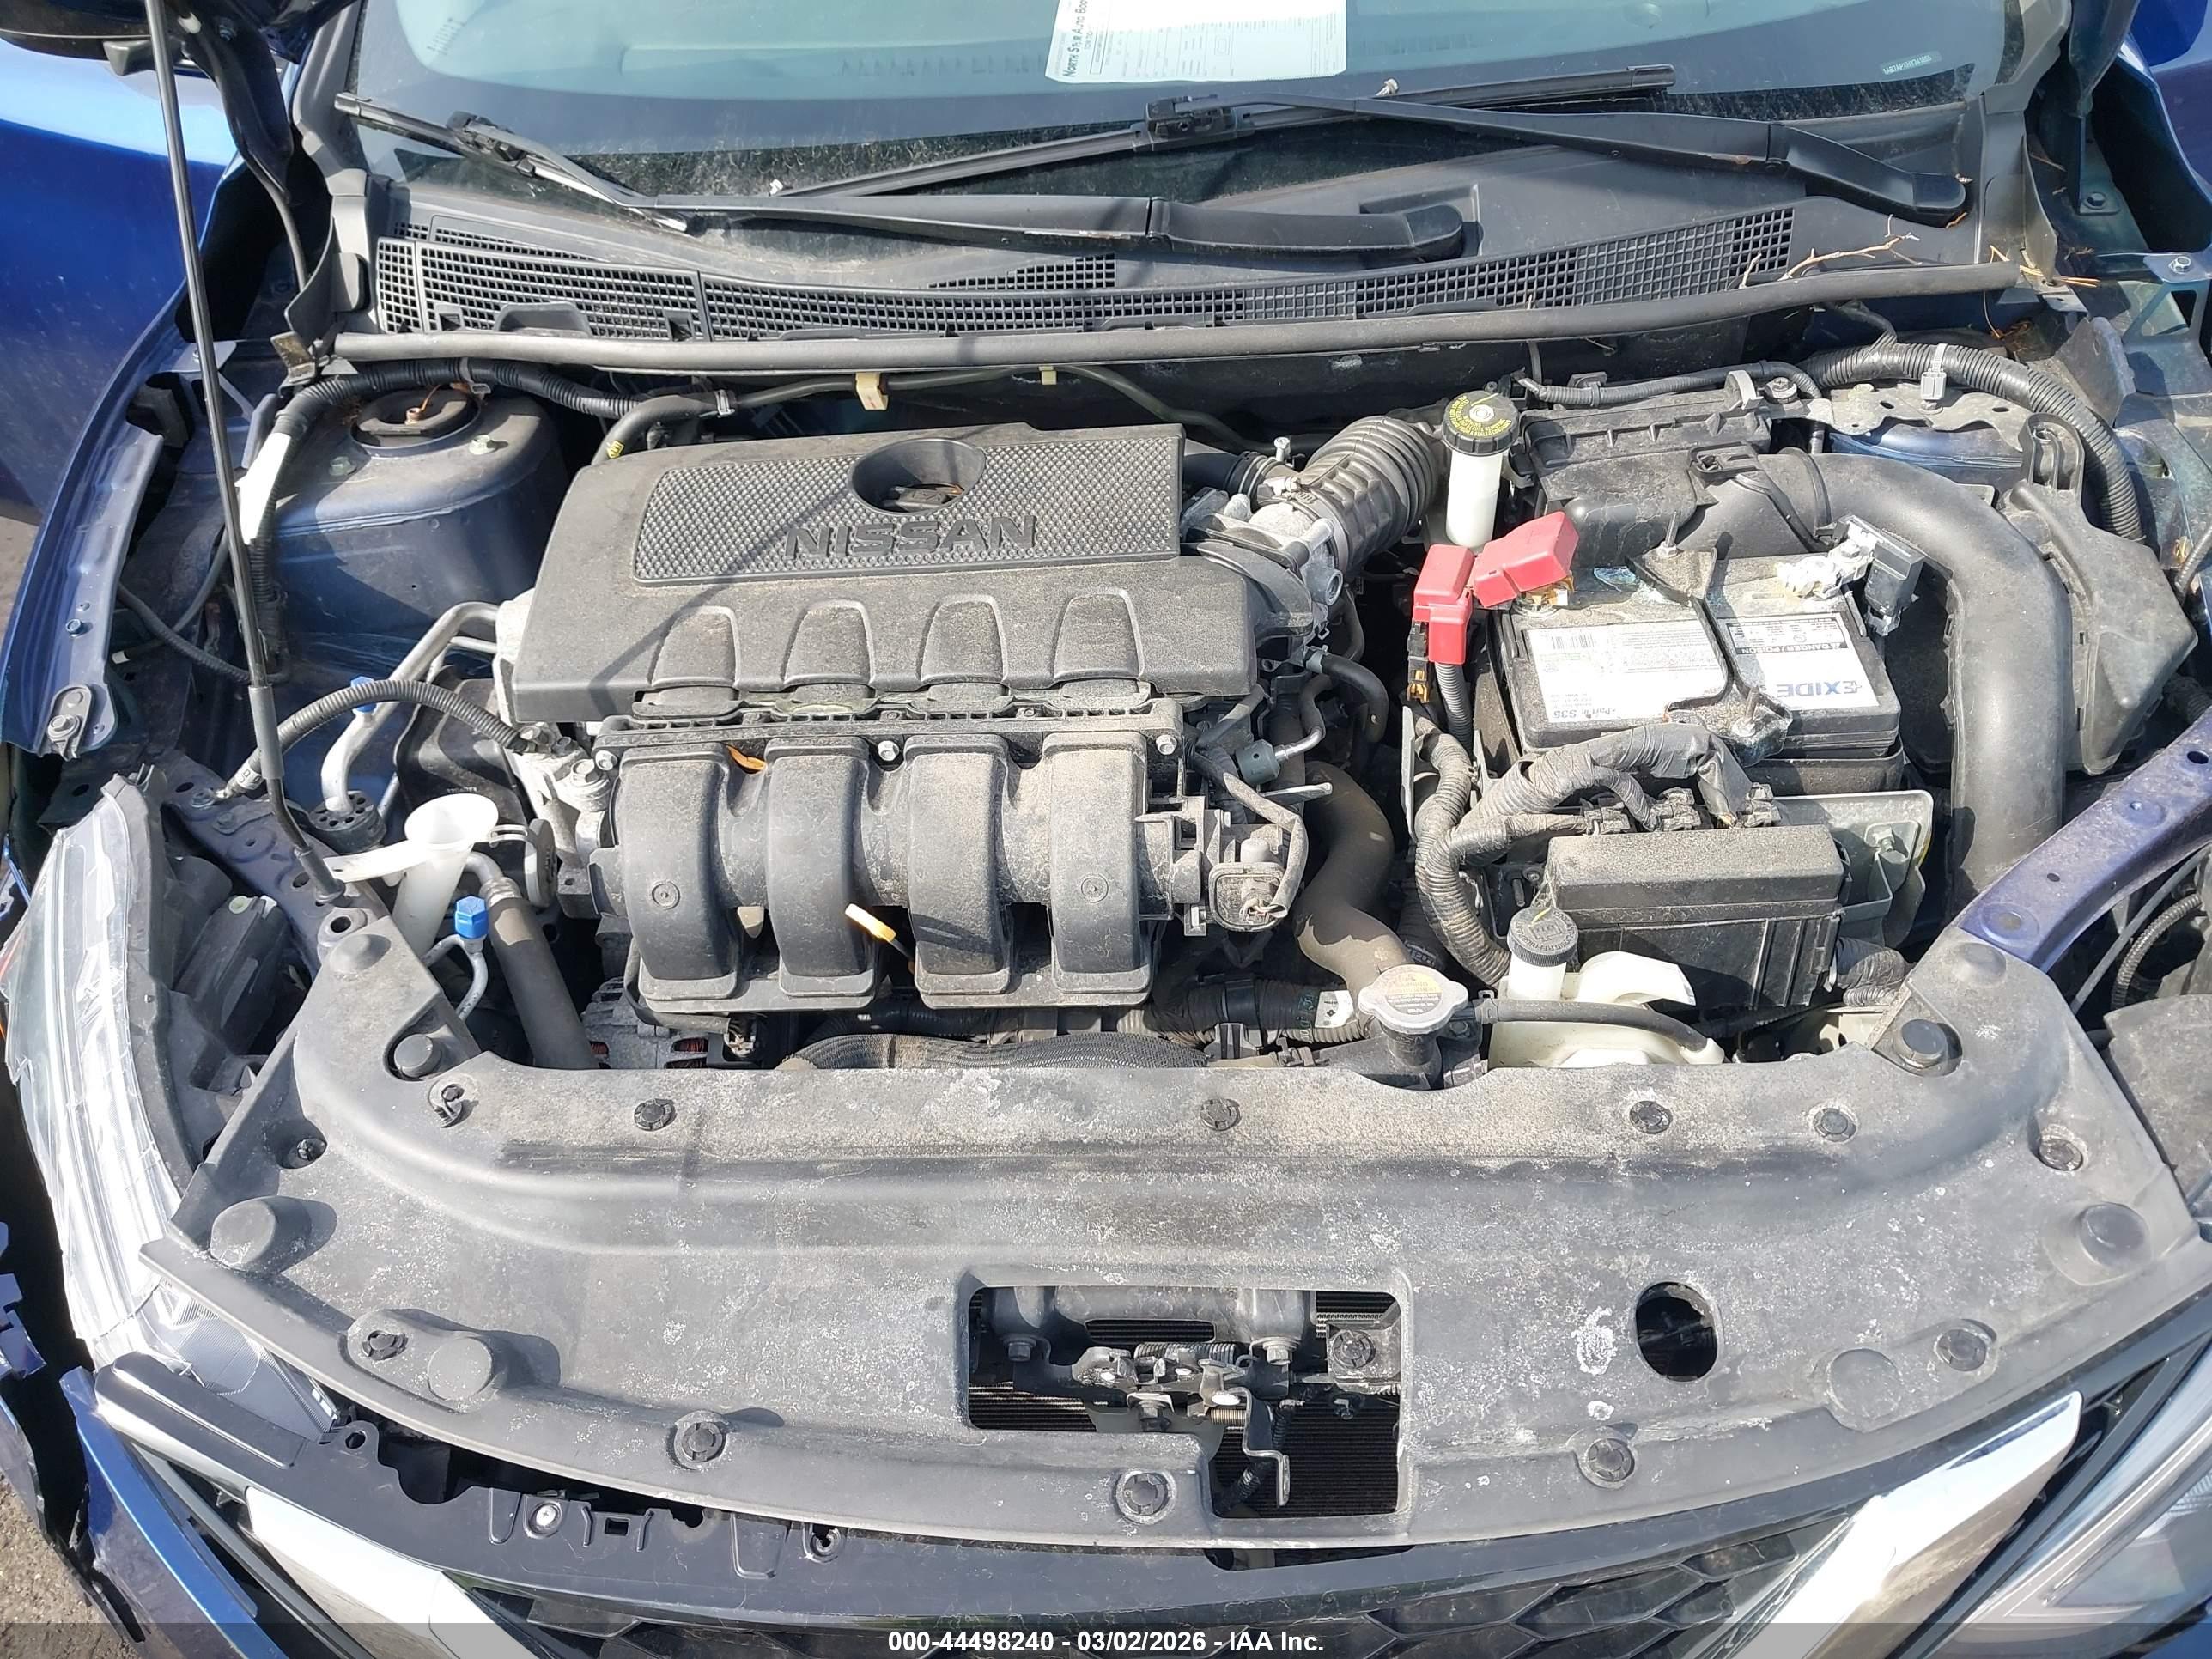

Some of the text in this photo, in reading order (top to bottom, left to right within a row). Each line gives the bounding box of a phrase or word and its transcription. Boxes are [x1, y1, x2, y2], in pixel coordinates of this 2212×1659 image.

[1063, 54, 1079, 77] NORTH
[1072, 16, 1085, 34] AUTO
[785, 515, 1038, 561] NISSAN
[1776, 680, 1863, 697] EXIDE
[1553, 709, 1577, 719] S35
